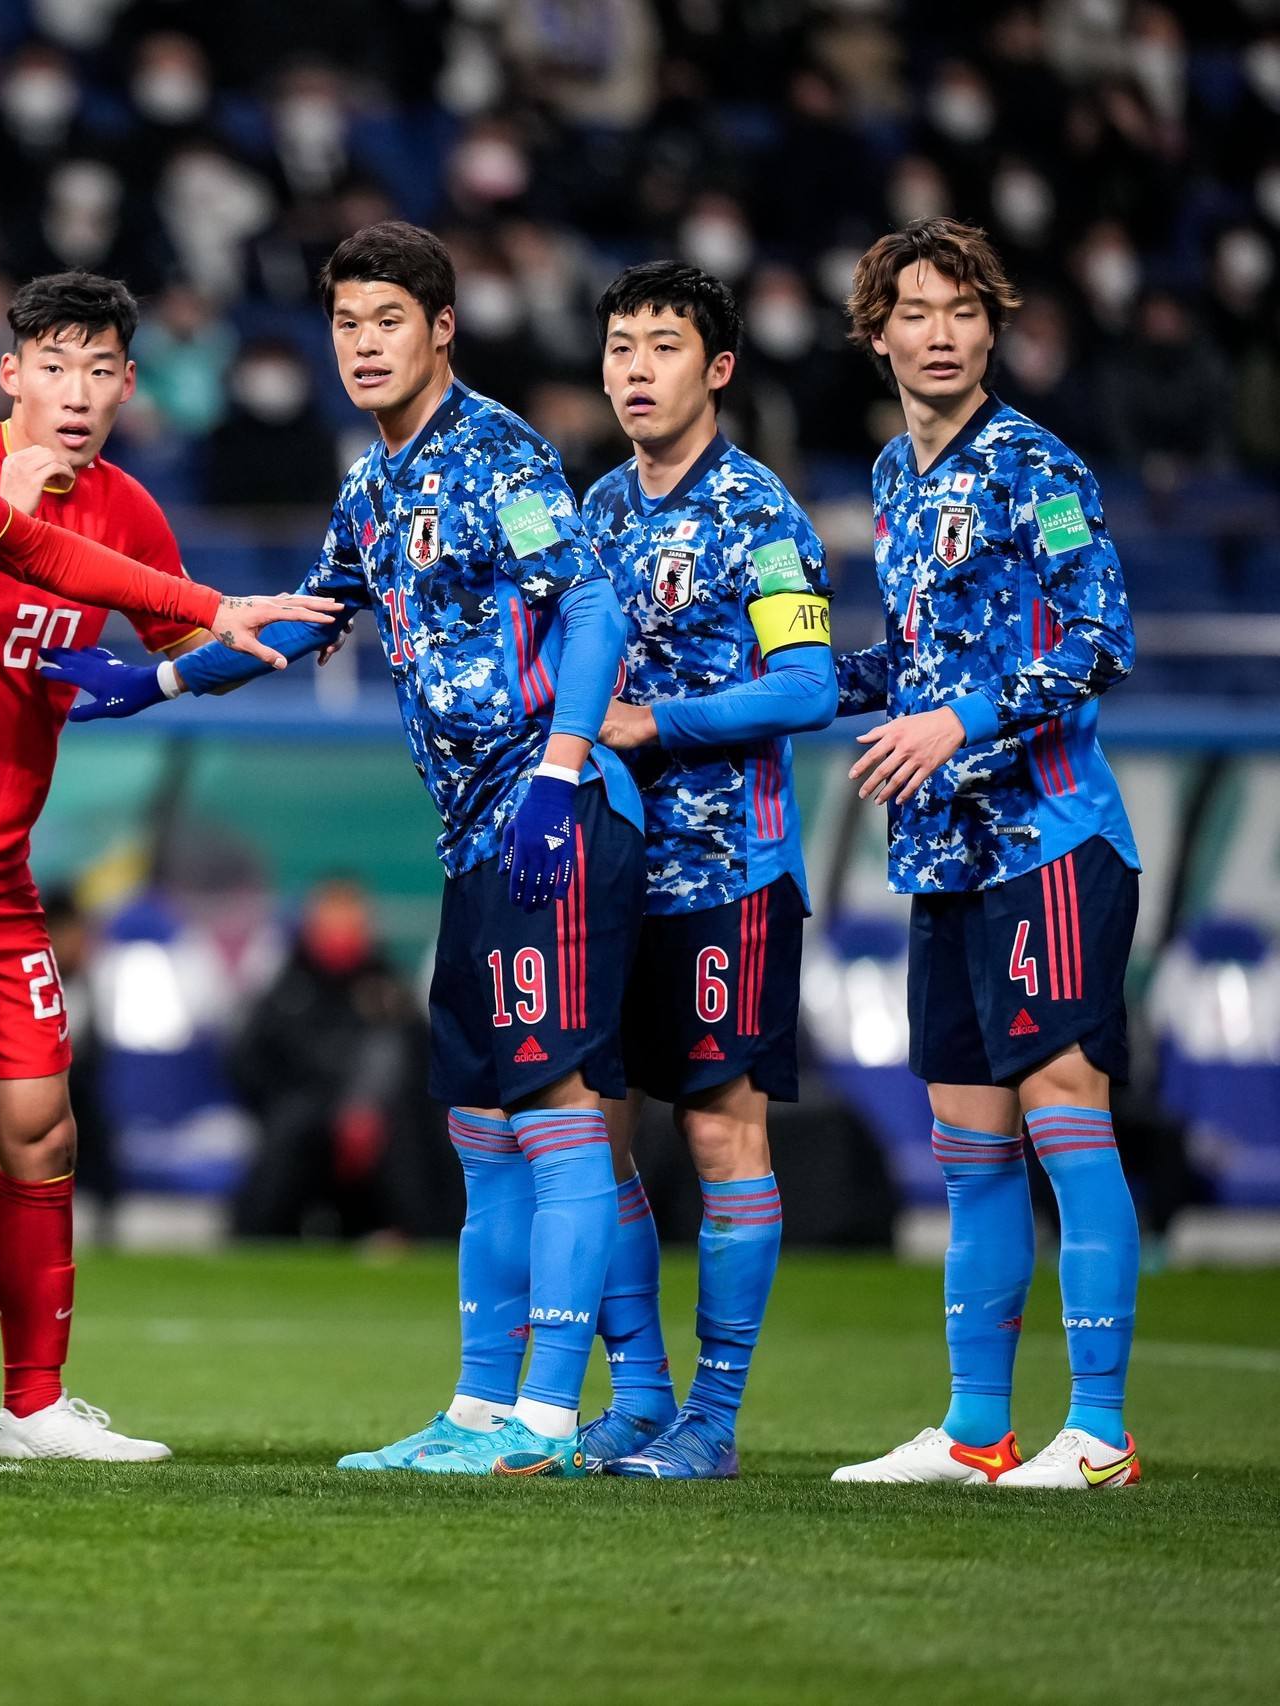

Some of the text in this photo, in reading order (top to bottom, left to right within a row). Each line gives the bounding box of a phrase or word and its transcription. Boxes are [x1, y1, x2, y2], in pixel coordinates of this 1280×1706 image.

[1041, 507, 1079, 524] LIVING
[1043, 513, 1081, 529] FOOTBALL
[1067, 524, 1085, 535] FIFA
[415, 549, 431, 560] JFA
[668, 550, 687, 558] JAPAN
[942, 547, 958, 558] JFA
[758, 553, 795, 569] LIVING
[760, 559, 797, 574] FOOTBALL
[781, 569, 800, 579] FIFA
[661, 591, 680, 603] JFA
[3, 603, 83, 670] 20
[1009, 919, 1039, 997] 4
[21, 945, 65, 1019] 2
[487, 946, 547, 1028] 19
[696, 945, 729, 1023] 6
[1009, 1024, 1040, 1037] adidas
[513, 1052, 549, 1063] adidas
[687, 1051, 726, 1061] adidas
[529, 1307, 590, 1324] JAPAN
